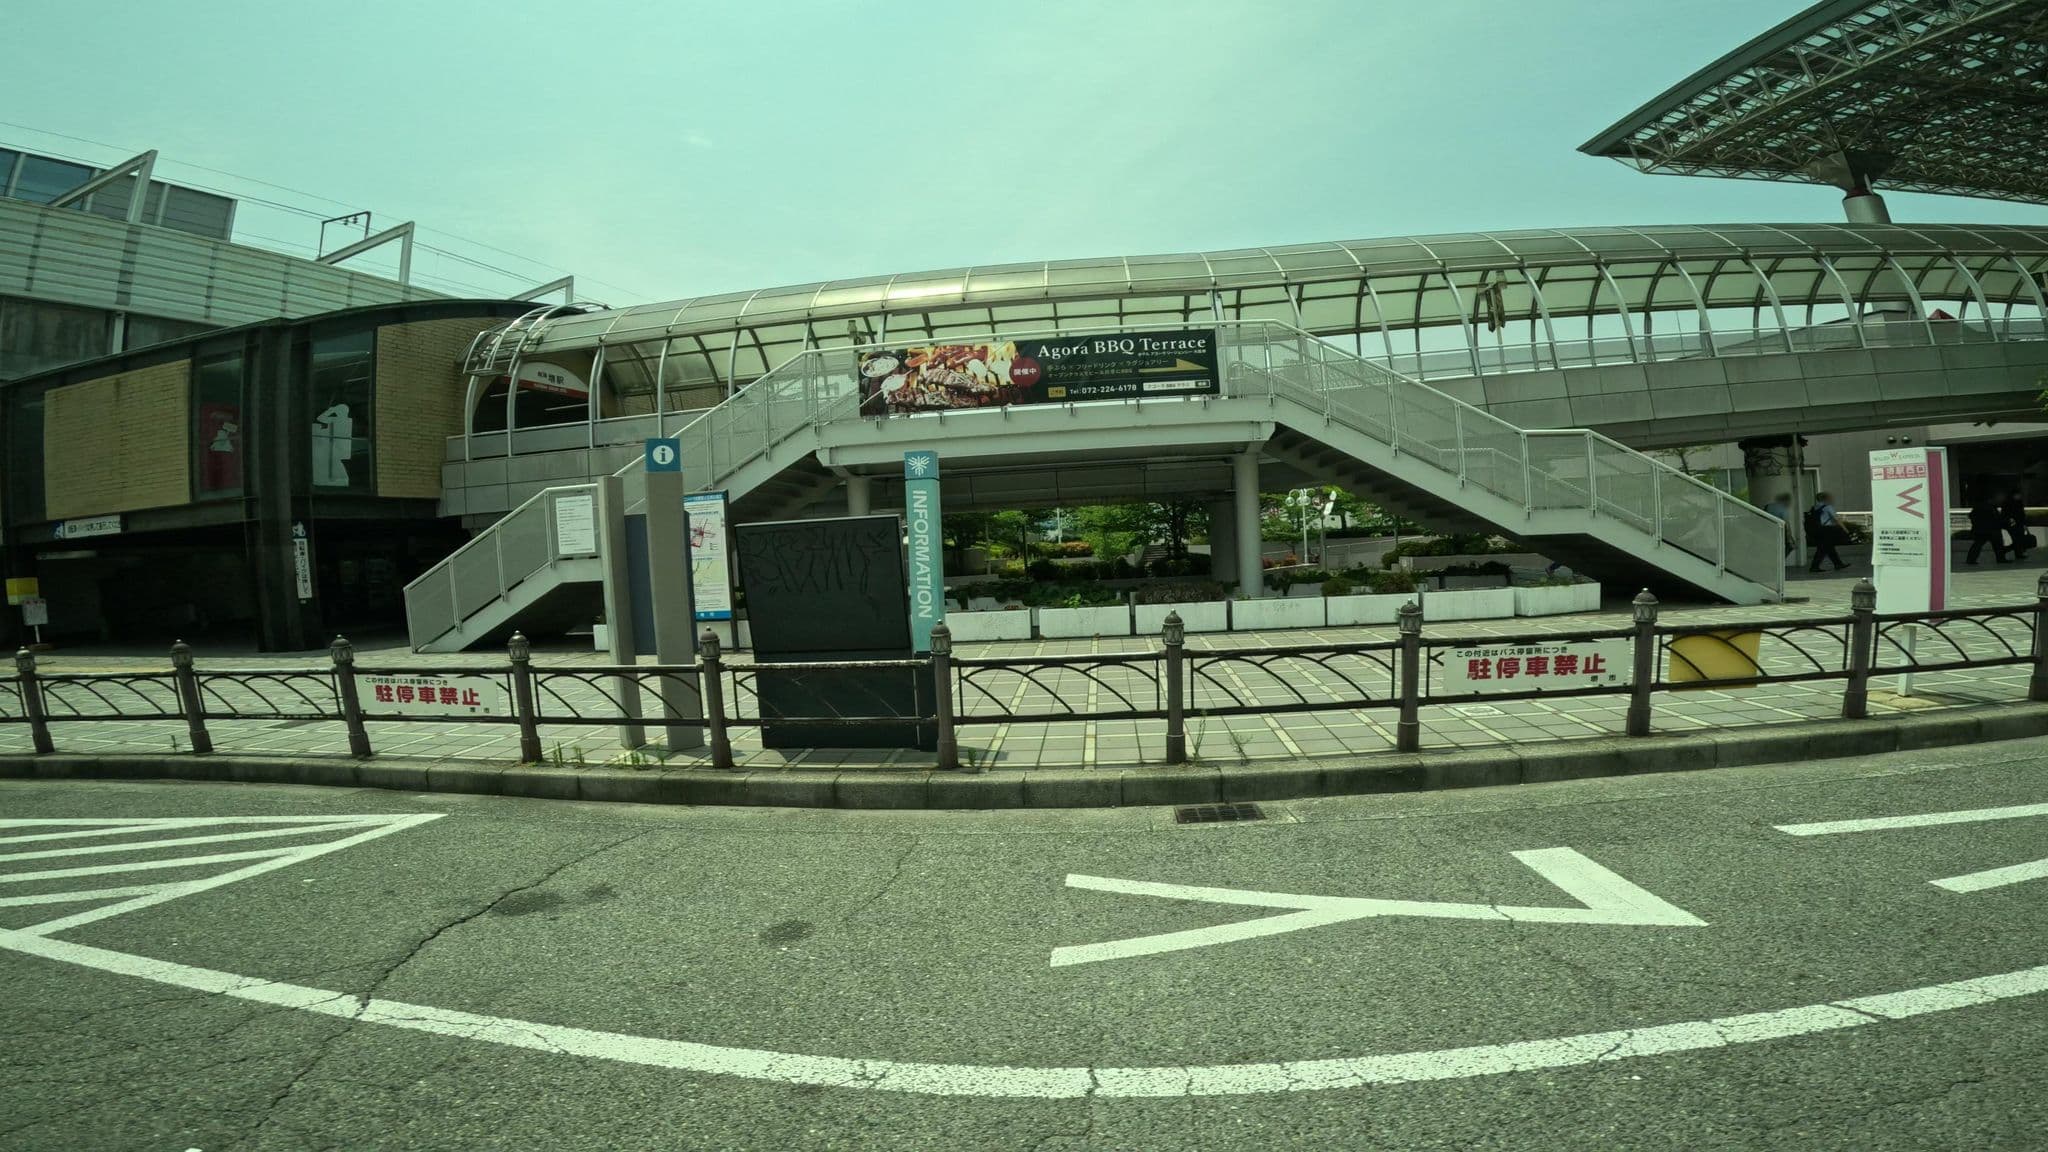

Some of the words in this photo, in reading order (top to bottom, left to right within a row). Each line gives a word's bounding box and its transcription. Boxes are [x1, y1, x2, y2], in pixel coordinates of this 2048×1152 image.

[1038, 343, 1088, 360] Agora
[1094, 339, 1135, 355] BBQ
[1138, 337, 1206, 351] Terrace
[913, 490, 933, 618] INFORMATION
[1456, 646, 1568, 658] この付近はバス停留所につき
[1467, 653, 1606, 680] 駐停車禁止
[365, 677, 448, 686] この付近はバス停留所につき
[375, 685, 481, 706] 駐停車禁止
